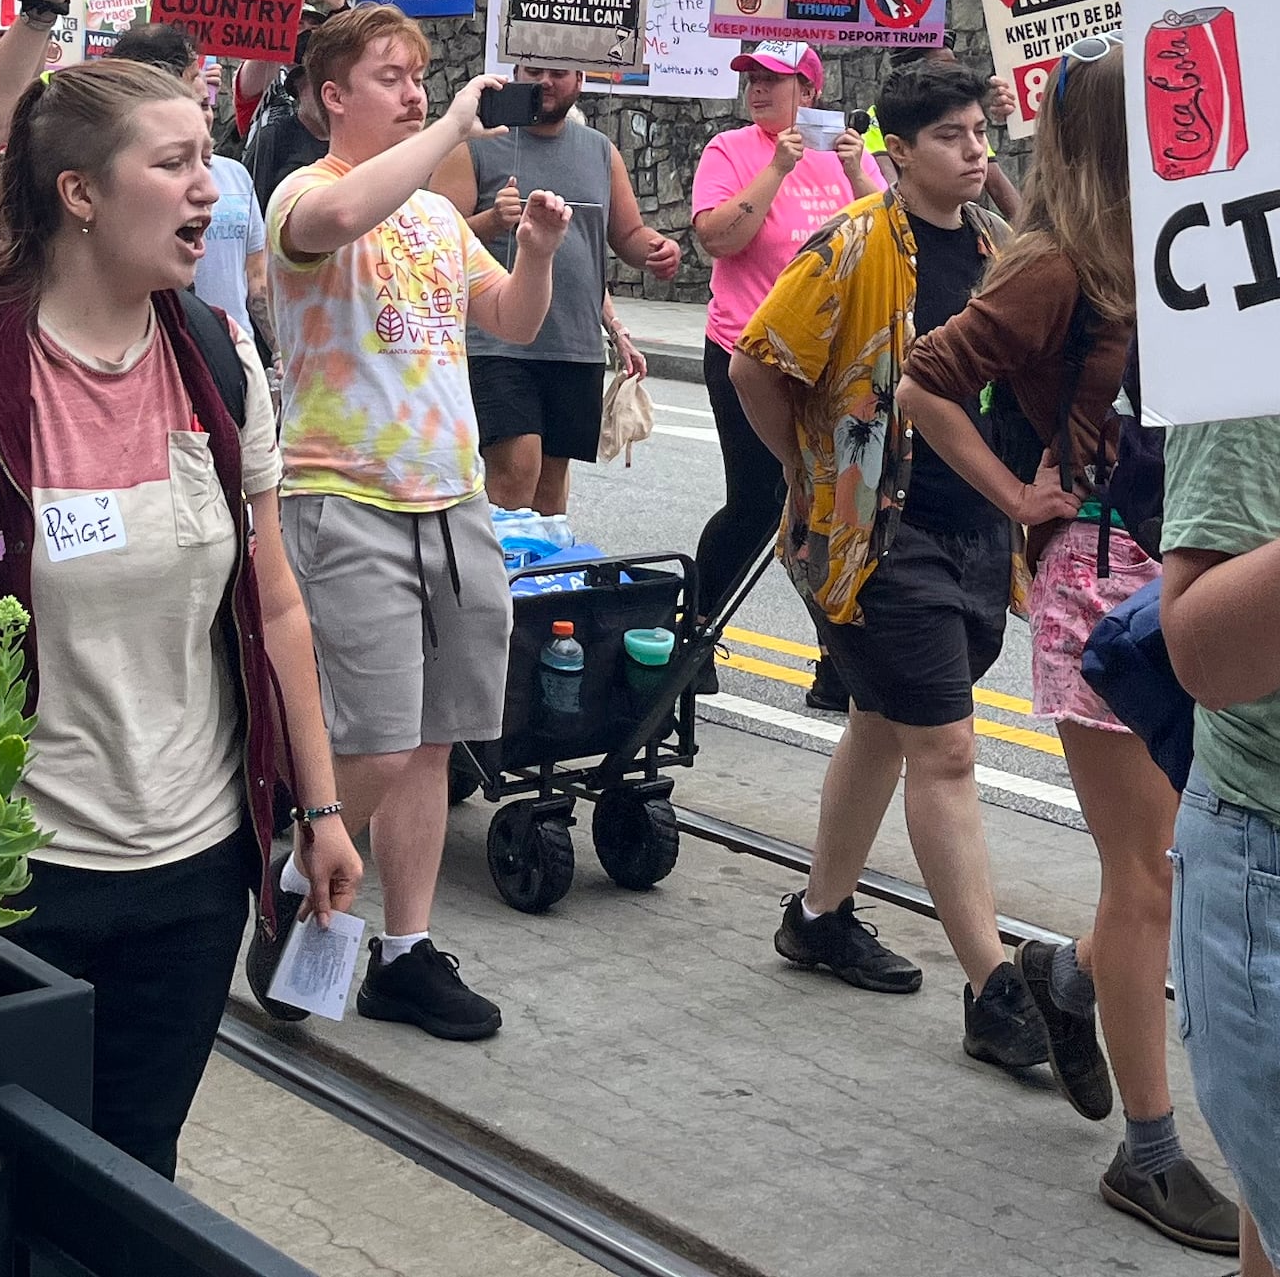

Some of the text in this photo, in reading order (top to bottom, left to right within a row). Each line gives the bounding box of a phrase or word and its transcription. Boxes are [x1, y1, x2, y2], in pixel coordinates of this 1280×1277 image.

[106, 8, 135, 21] rage
[519, 2, 623, 24] YOU STILL CAN
[797, 4, 852, 16] TRUMP
[646, 14, 709, 36] of thes
[713, 23, 748, 35] KEEP
[838, 30, 889, 42] DEPORT
[891, 32, 938, 43] TRUMP
[1005, 8, 1103, 44] KNEW IT'D BE
[222, 24, 291, 52] SMALL
[1023, 39, 1050, 60] BUT
[654, 63, 692, 75] Matthew
[42, 507, 116, 551] PAIGE
